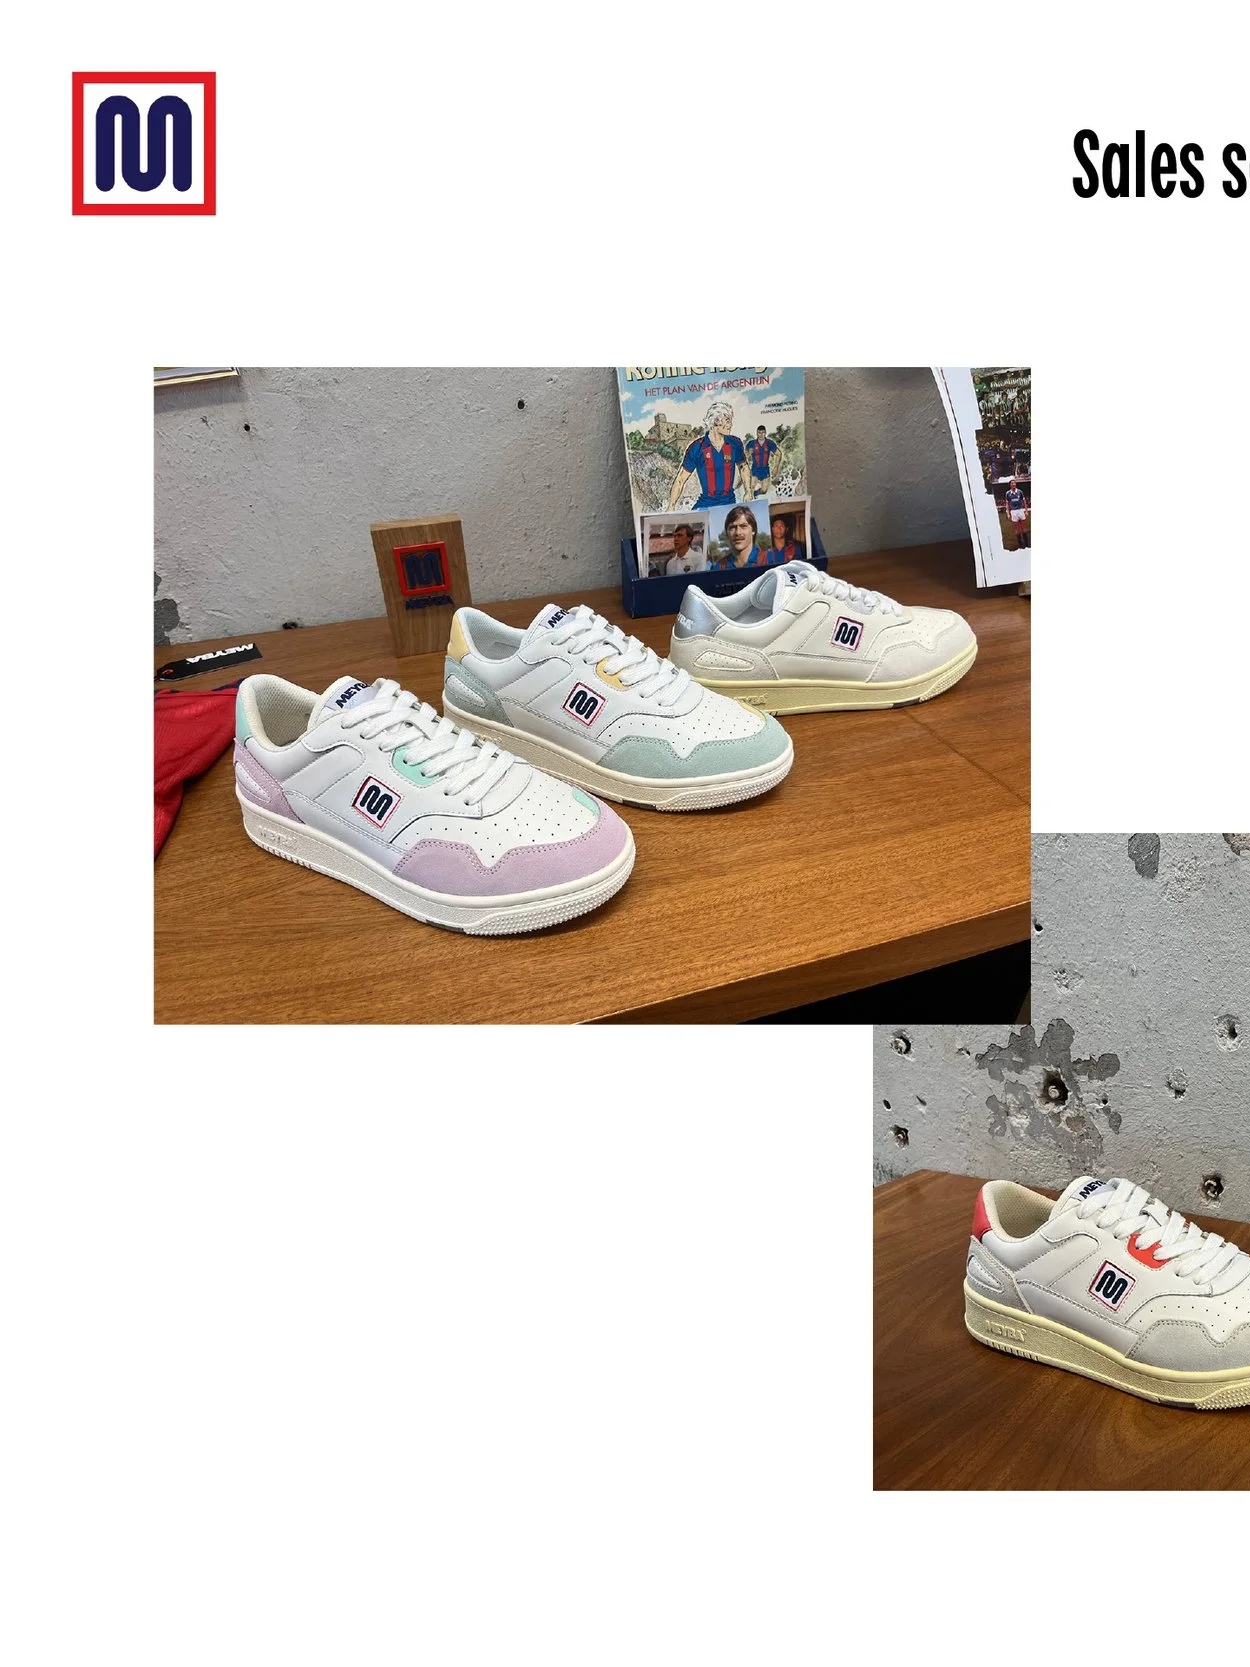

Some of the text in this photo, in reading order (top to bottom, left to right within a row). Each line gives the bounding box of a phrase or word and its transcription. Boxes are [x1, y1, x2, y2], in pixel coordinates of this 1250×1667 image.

[644, 386, 660, 397] HET
[662, 384, 686, 395] PLAN
[687, 382, 706, 393] VAN
[707, 381, 718, 391] DE
[548, 609, 570, 628] MEY
[335, 682, 369, 709] MEYB
